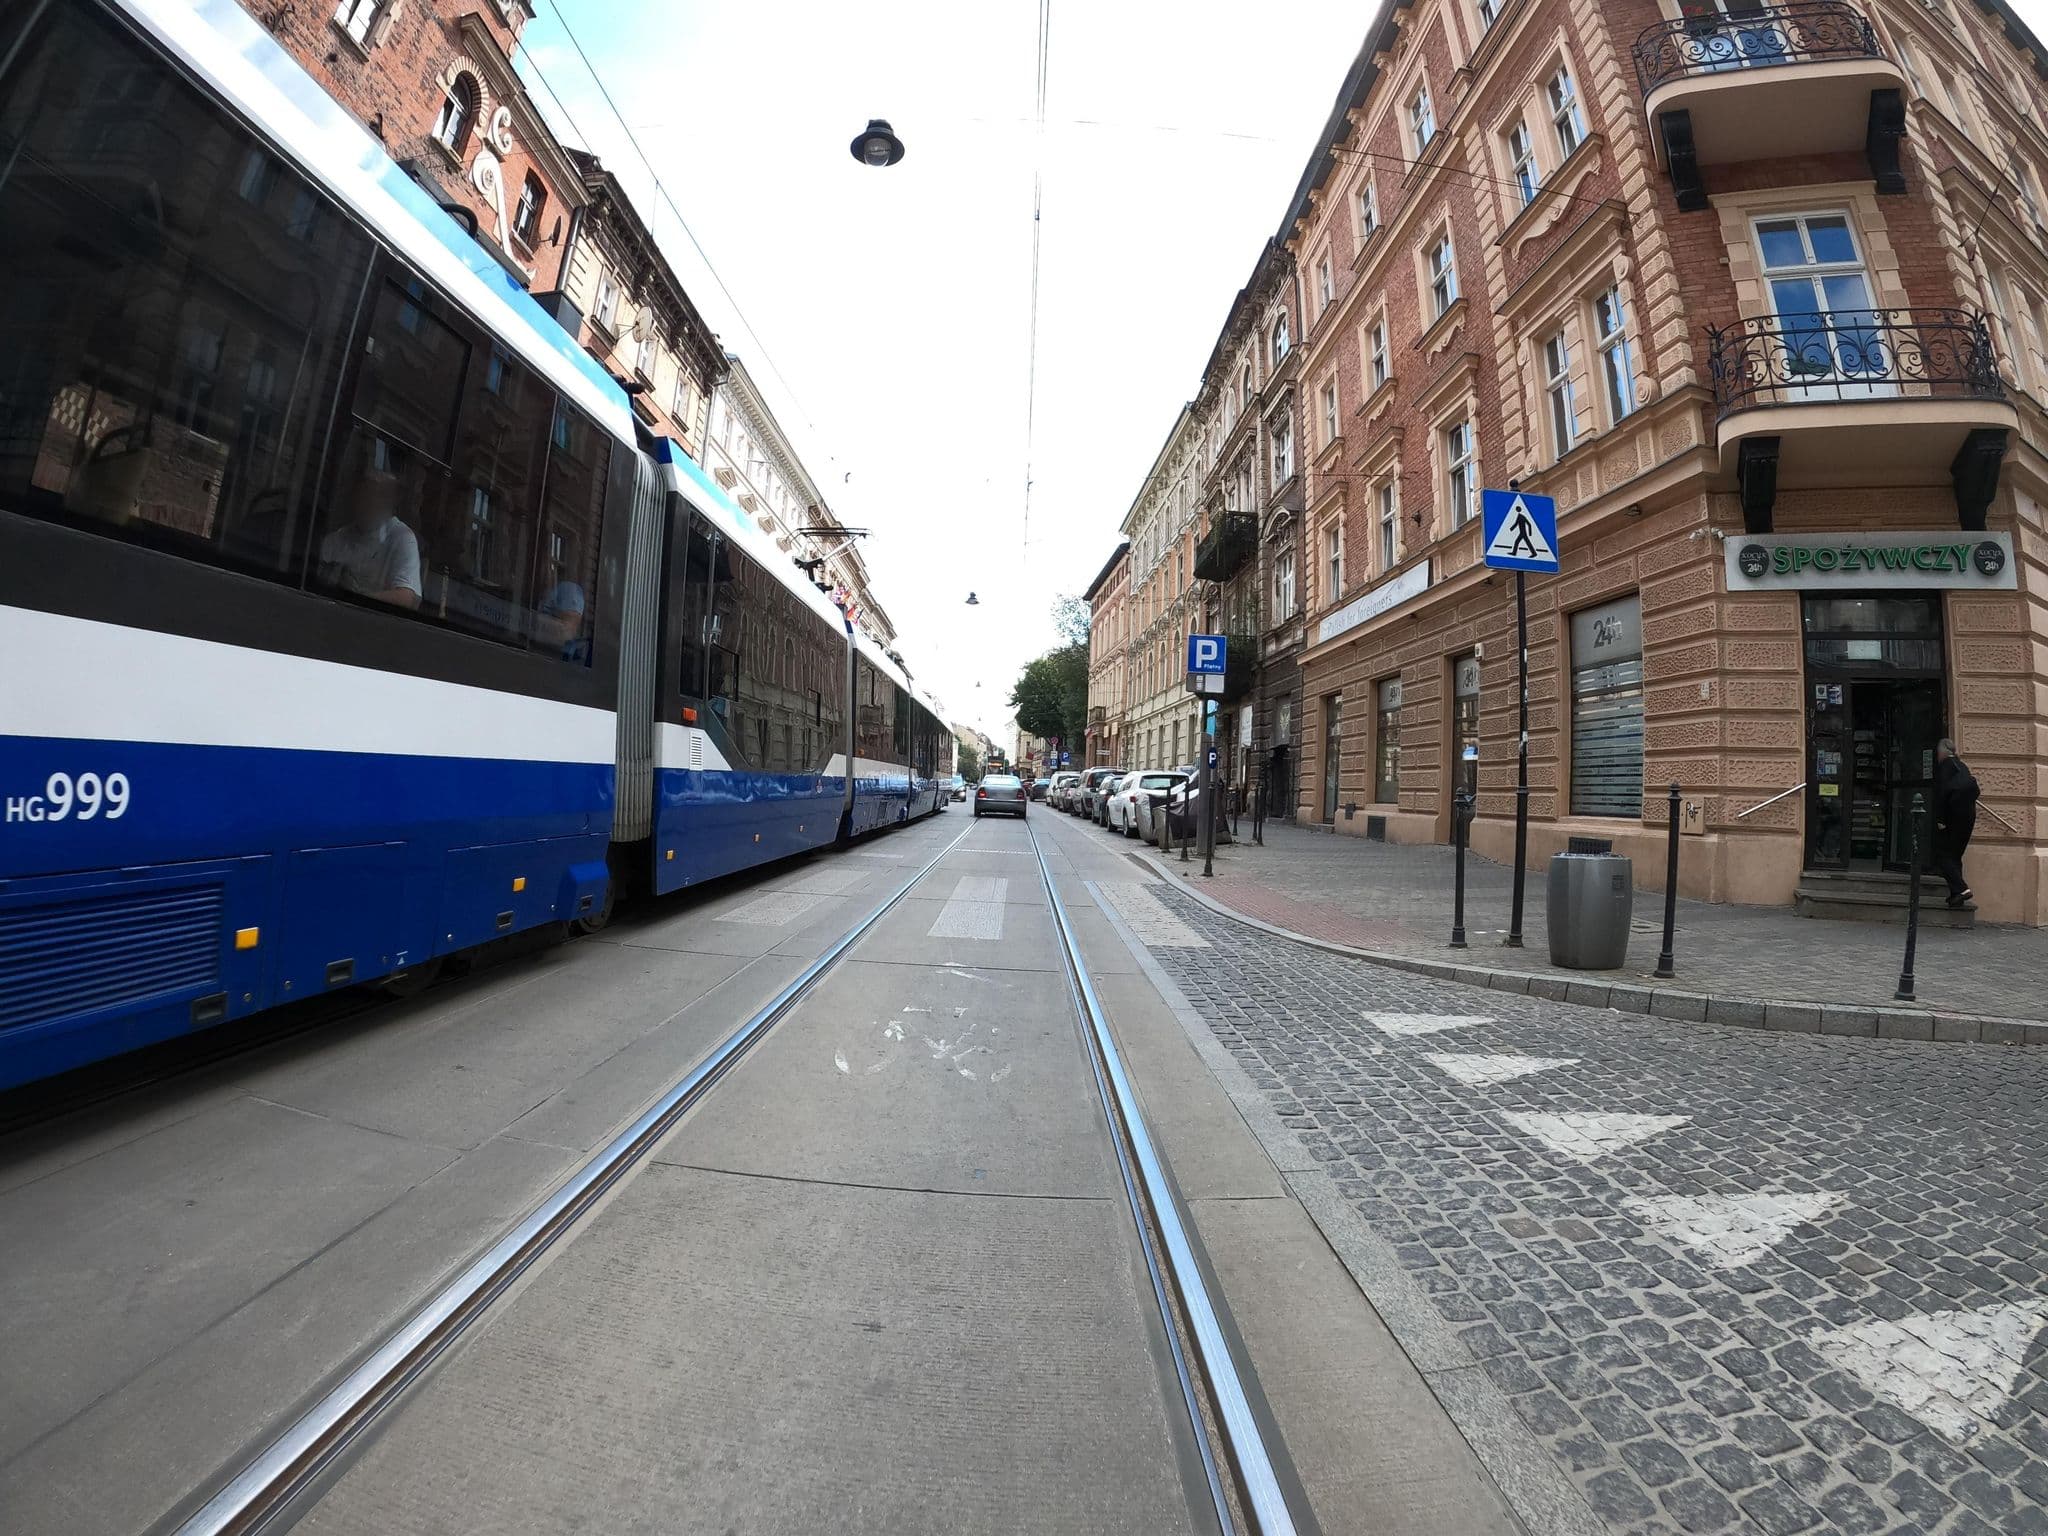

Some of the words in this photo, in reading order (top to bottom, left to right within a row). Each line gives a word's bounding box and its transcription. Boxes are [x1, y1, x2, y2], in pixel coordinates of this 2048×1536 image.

[1773, 544, 1972, 574] SPOŻYWCZY
[1748, 563, 1762, 573] 24h
[1985, 560, 1999, 571] 24h
[1357, 594, 1393, 619] foreigners
[1196, 639, 1218, 669] P
[1063, 752, 1069, 760] P
[1209, 752, 1217, 764] P
